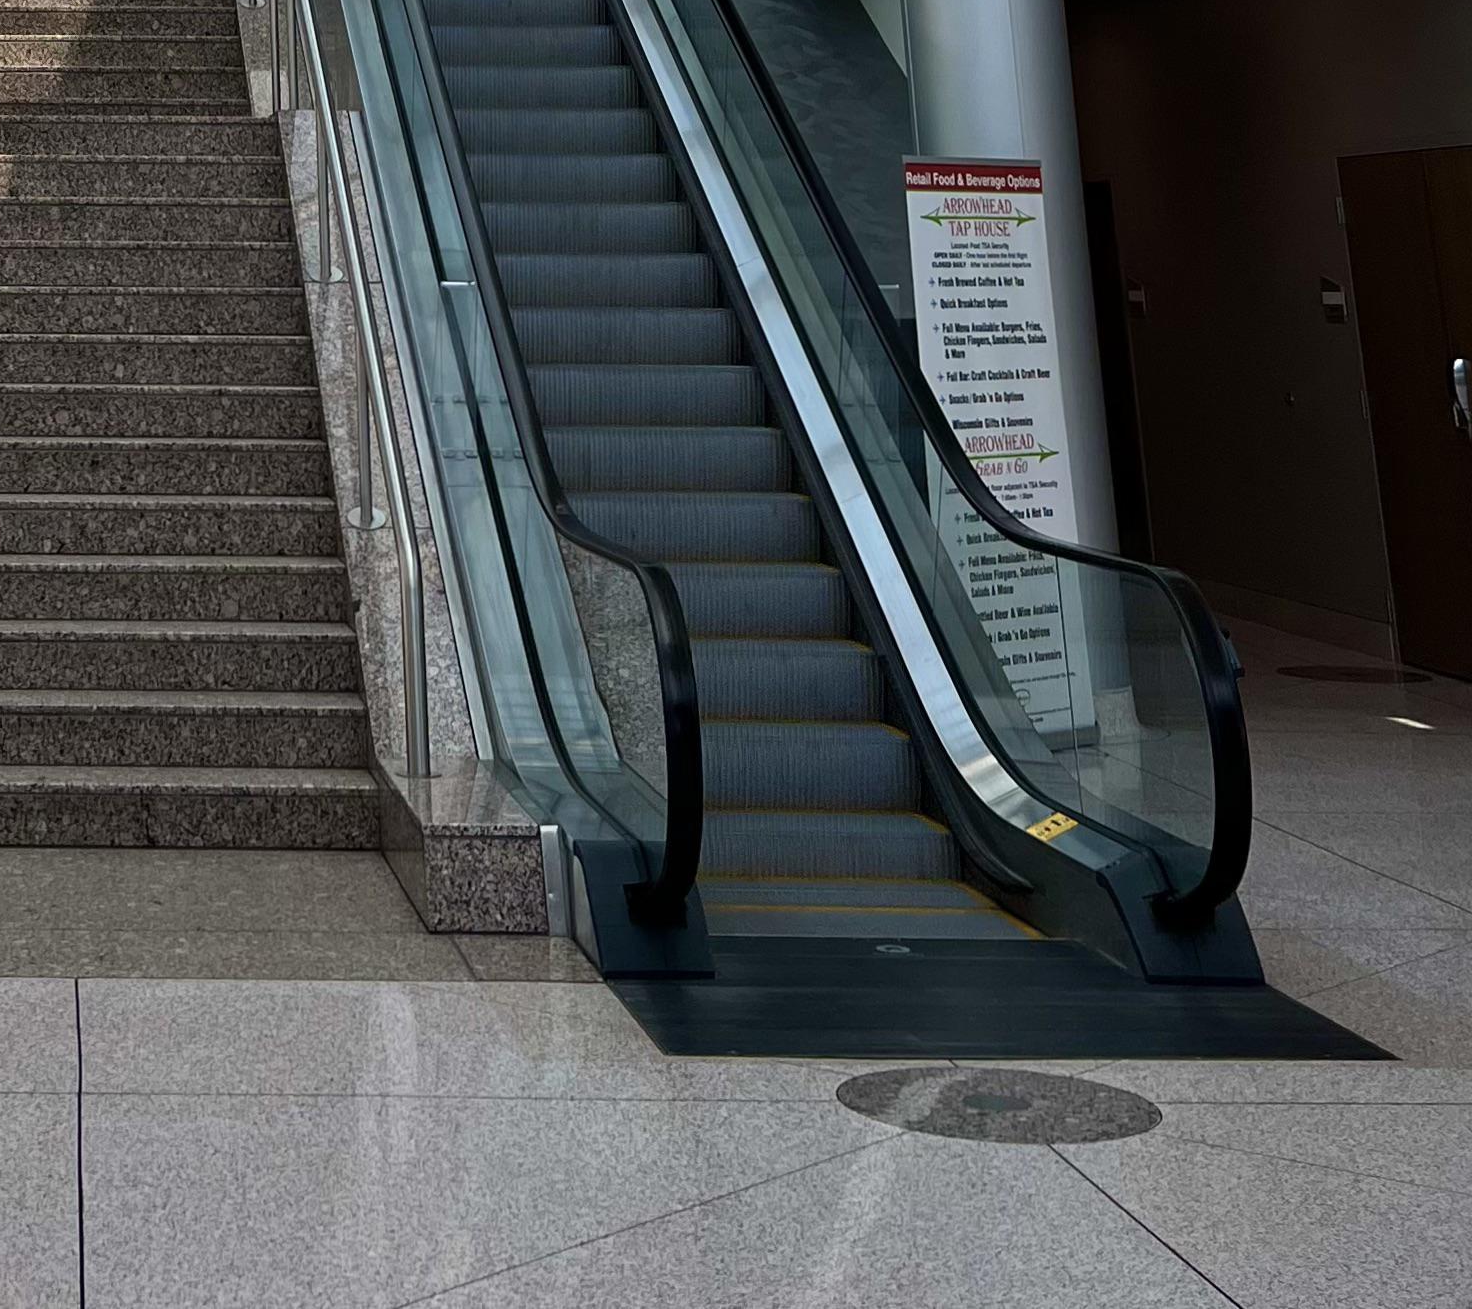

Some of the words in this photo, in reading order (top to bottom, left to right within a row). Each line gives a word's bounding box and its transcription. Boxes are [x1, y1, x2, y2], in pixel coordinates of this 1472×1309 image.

[906, 171, 931, 185] Retail
[933, 172, 955, 187] Food
[957, 173, 964, 187] &
[966, 173, 1006, 190] Beverage
[1007, 174, 1040, 190] Options
[943, 196, 1013, 214] ARROWHEAD
[948, 220, 970, 237] TAP
[974, 221, 1011, 237] HOUSE
[964, 433, 1034, 454] ARROWHEAD
